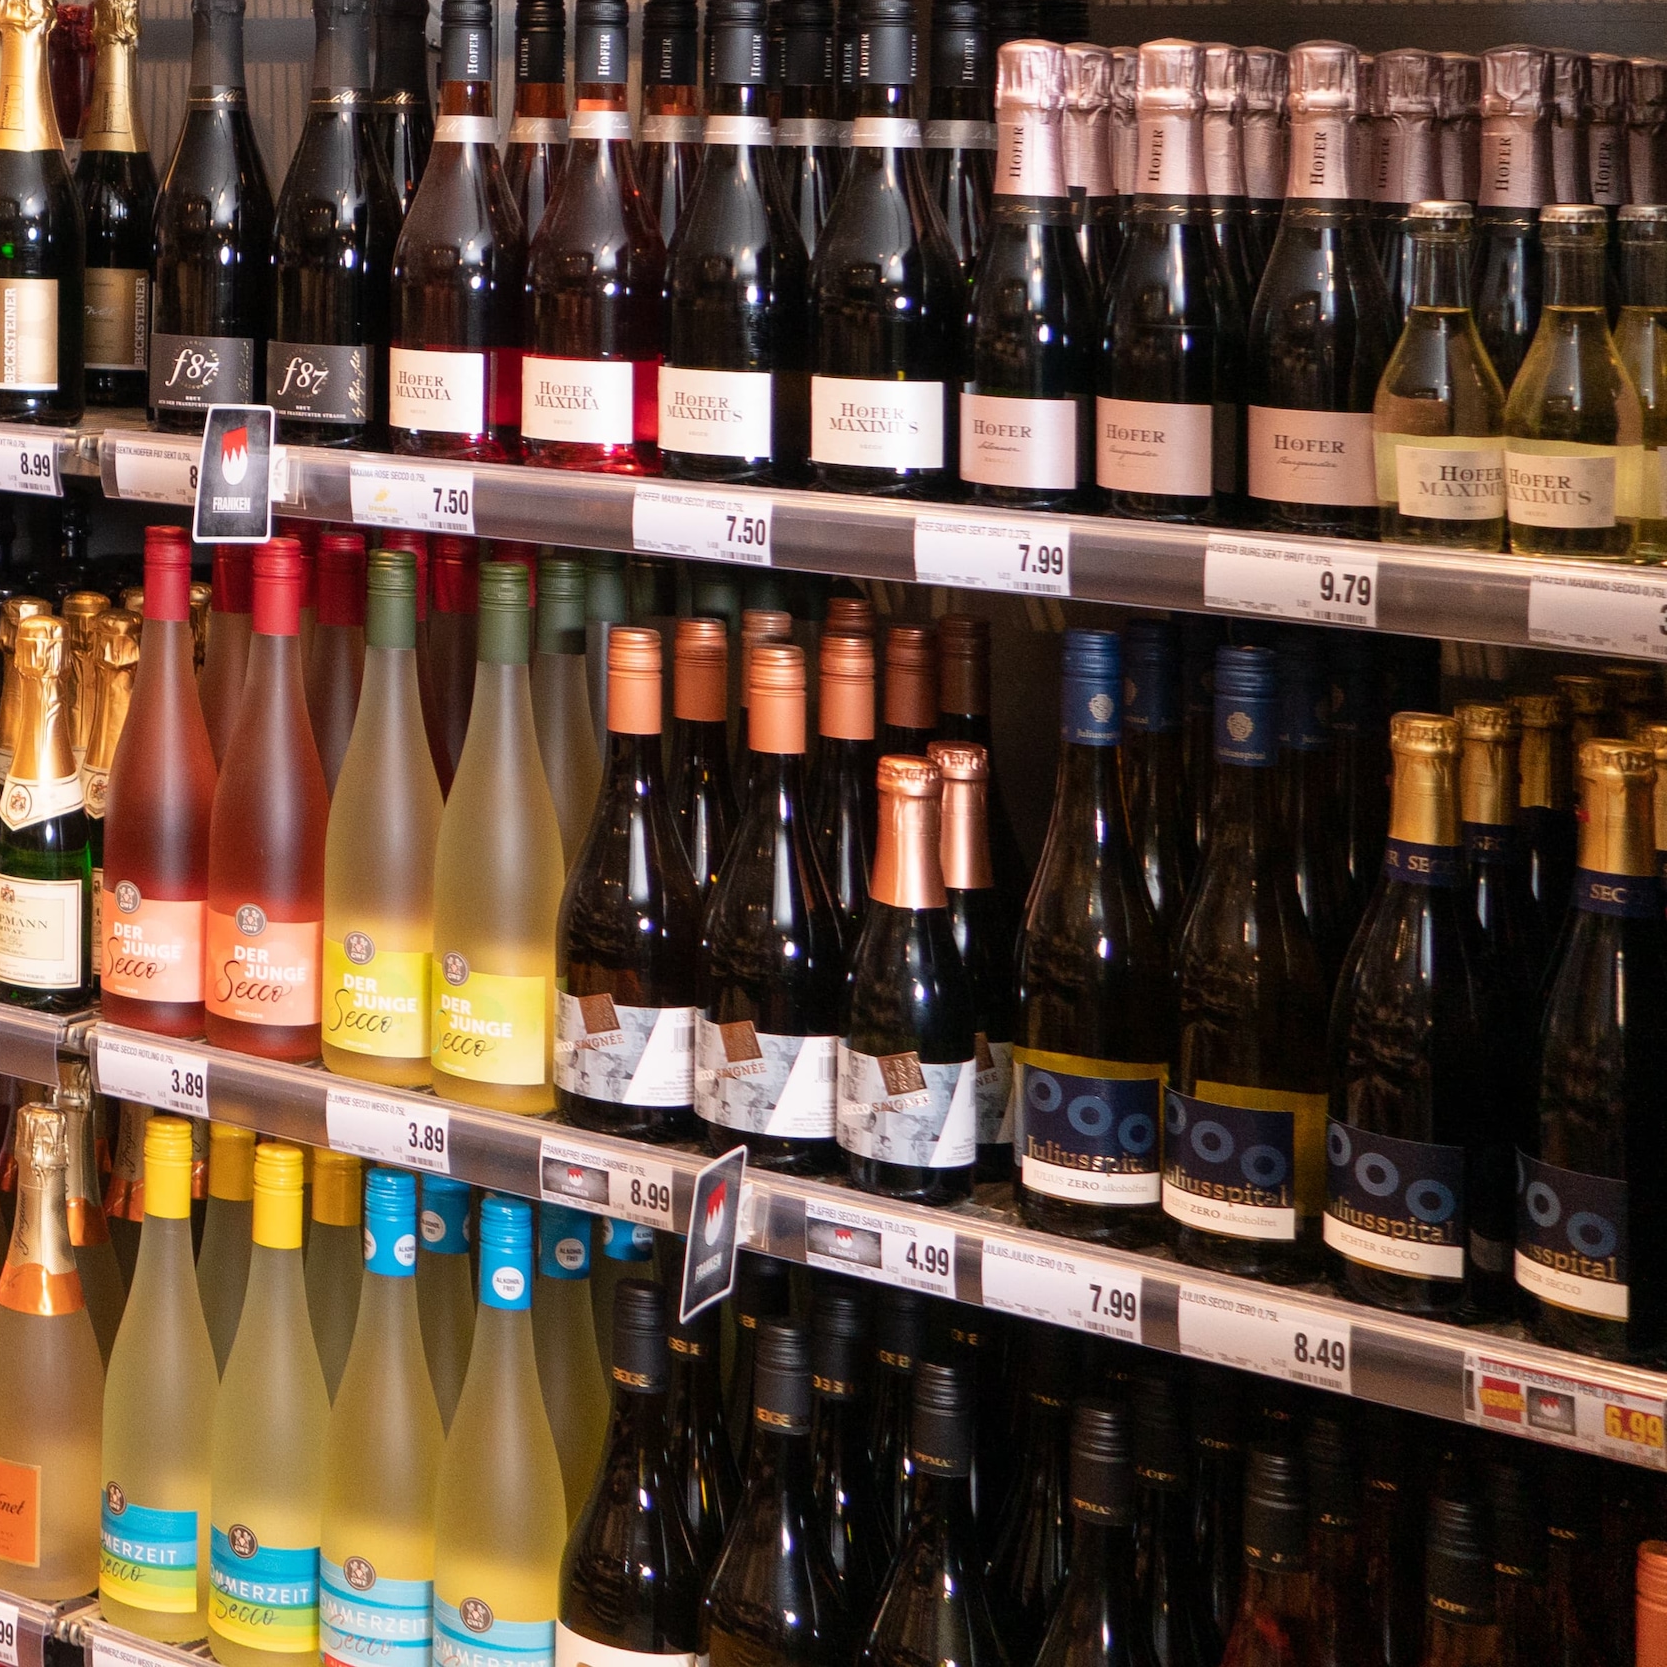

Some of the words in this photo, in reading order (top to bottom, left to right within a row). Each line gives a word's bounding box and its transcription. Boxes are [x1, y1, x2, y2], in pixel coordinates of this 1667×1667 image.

[134, 276, 145, 365] BECKSTEINER
[4, 287, 17, 383] BECKSTEINER
[396, 385, 451, 401] MAXIMA
[534, 395, 599, 411] MAXIMA
[667, 405, 743, 423] MAXIMUS
[21, 453, 51, 477] 8.99
[213, 497, 250, 511] FRANKEN
[433, 487, 468, 515] 7.50
[726, 515, 765, 545] 7.50
[1019, 545, 1063, 575] 7.99
[1284, 552, 1305, 564] BRUT
[1320, 571, 1371, 606] 9.79
[114, 922, 142, 940] DER
[105, 937, 166, 979] Secco
[122, 940, 181, 959] JUNGE
[234, 945, 269, 964] DER
[214, 960, 293, 1003] Secco
[244, 964, 307, 981] JUNGE
[343, 973, 377, 993] DER
[328, 989, 393, 1033] Secco
[353, 993, 417, 1013] JUNGE
[171, 1069, 203, 1098] 3.89
[409, 1122, 444, 1152] 3.89
[631, 1179, 670, 1212] 8.99
[1067, 1177, 1099, 1191] ZERO
[1190, 1204, 1220, 1219] ZERO
[906, 1242, 949, 1276] 4.99
[1379, 1242, 1420, 1261] SECCO
[1090, 1284, 1136, 1322] 7.99
[1294, 1332, 1346, 1372] 8.49
[1604, 1403, 1663, 1448] 6.99
